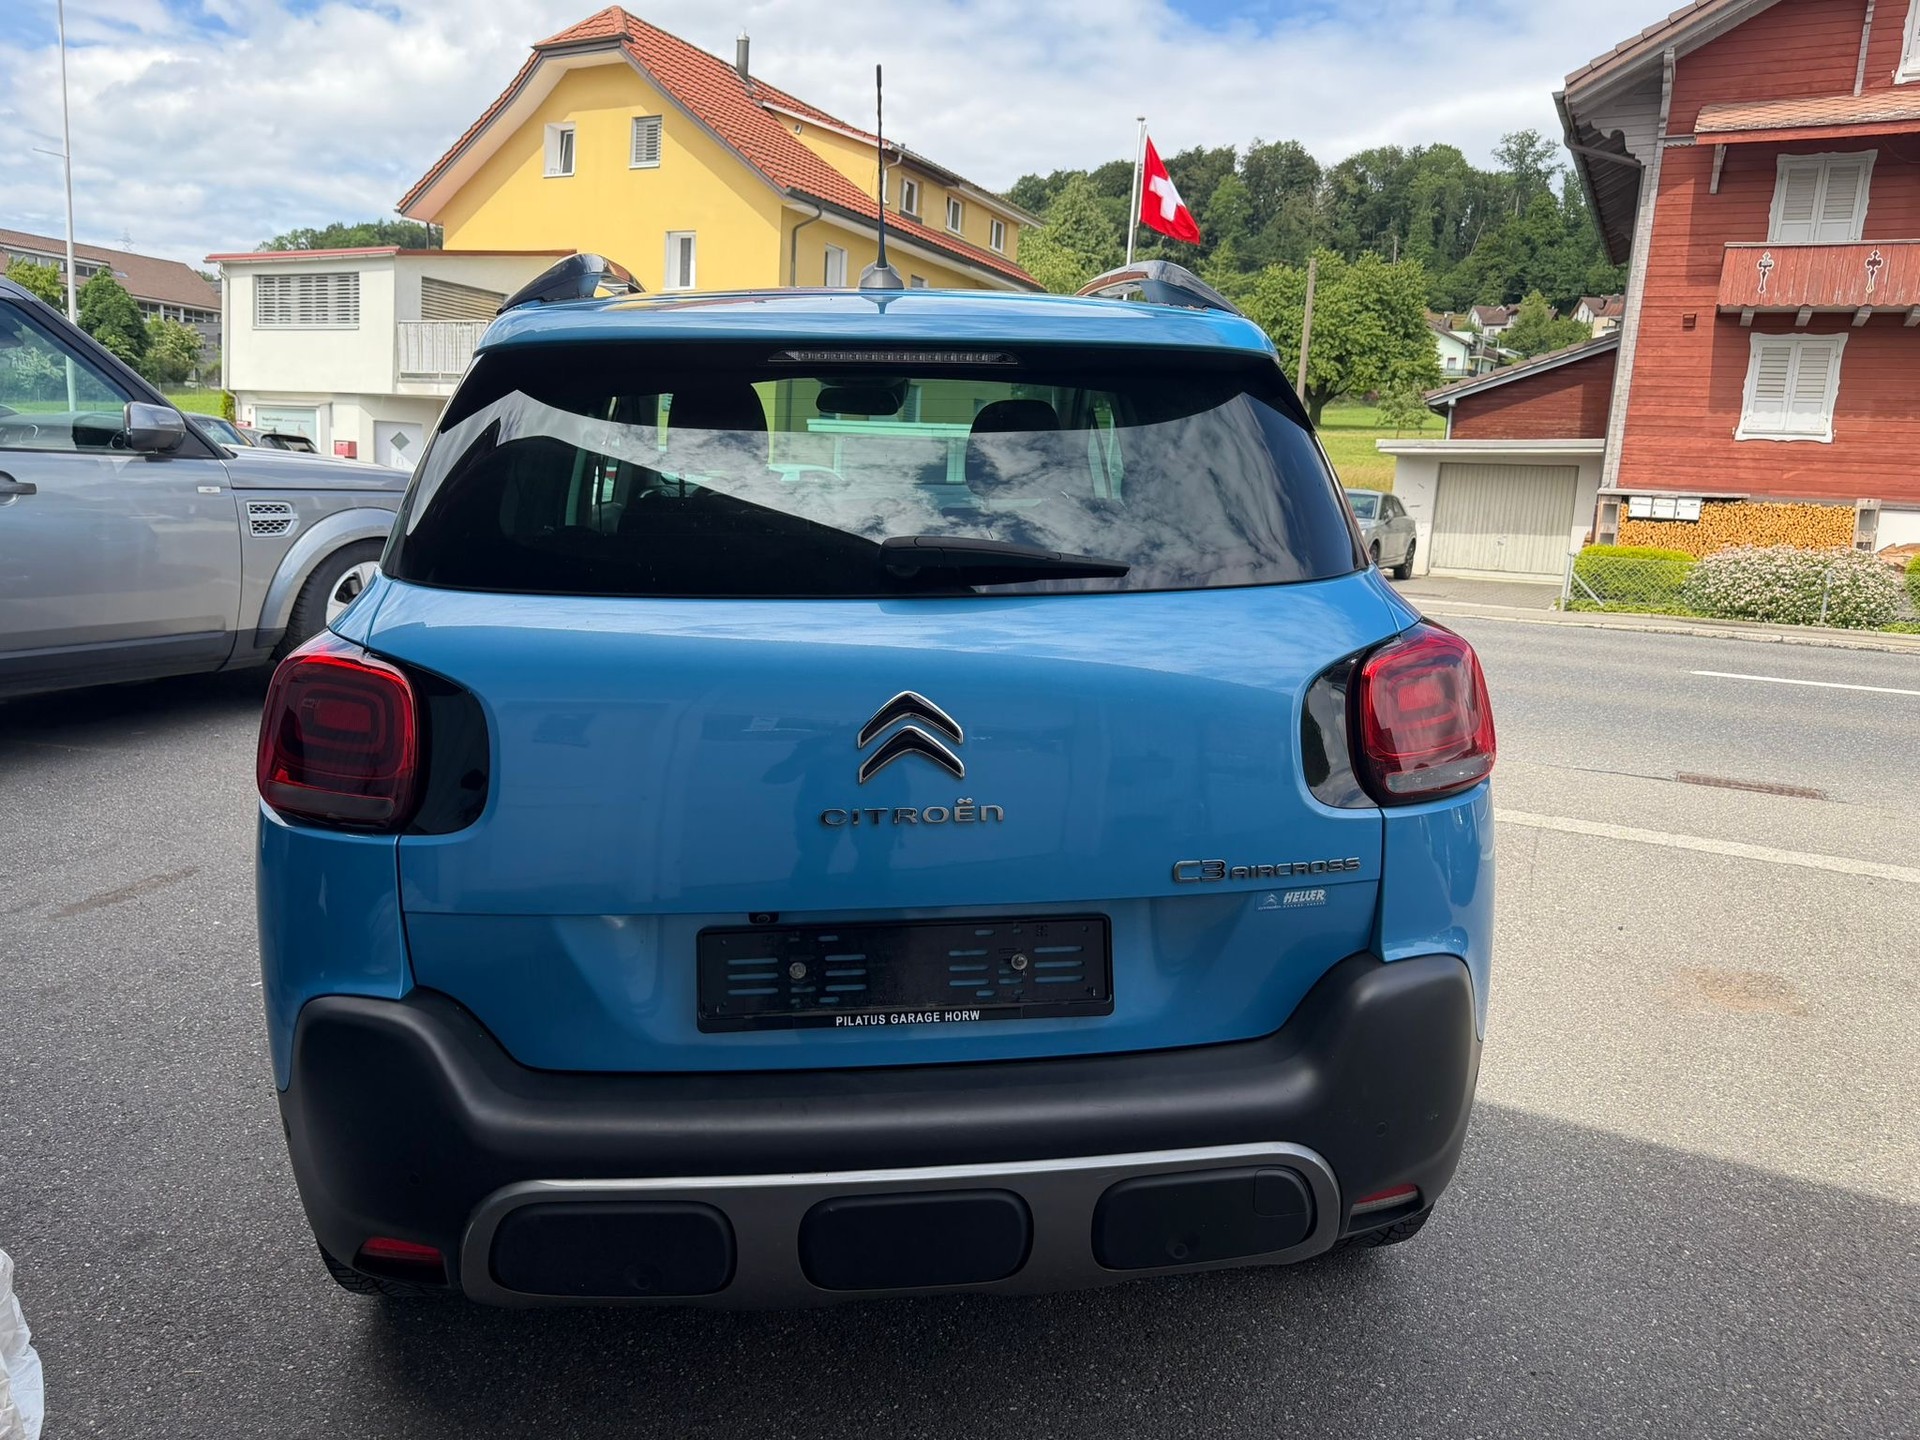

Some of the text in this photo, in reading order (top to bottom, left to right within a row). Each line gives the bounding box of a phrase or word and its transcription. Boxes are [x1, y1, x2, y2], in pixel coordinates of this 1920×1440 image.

[1173, 856, 1360, 883] C3 AIRCROSS
[1283, 889, 1326, 904] HELLER
[836, 1010, 980, 1027] PILATUS GARAGE HORW
